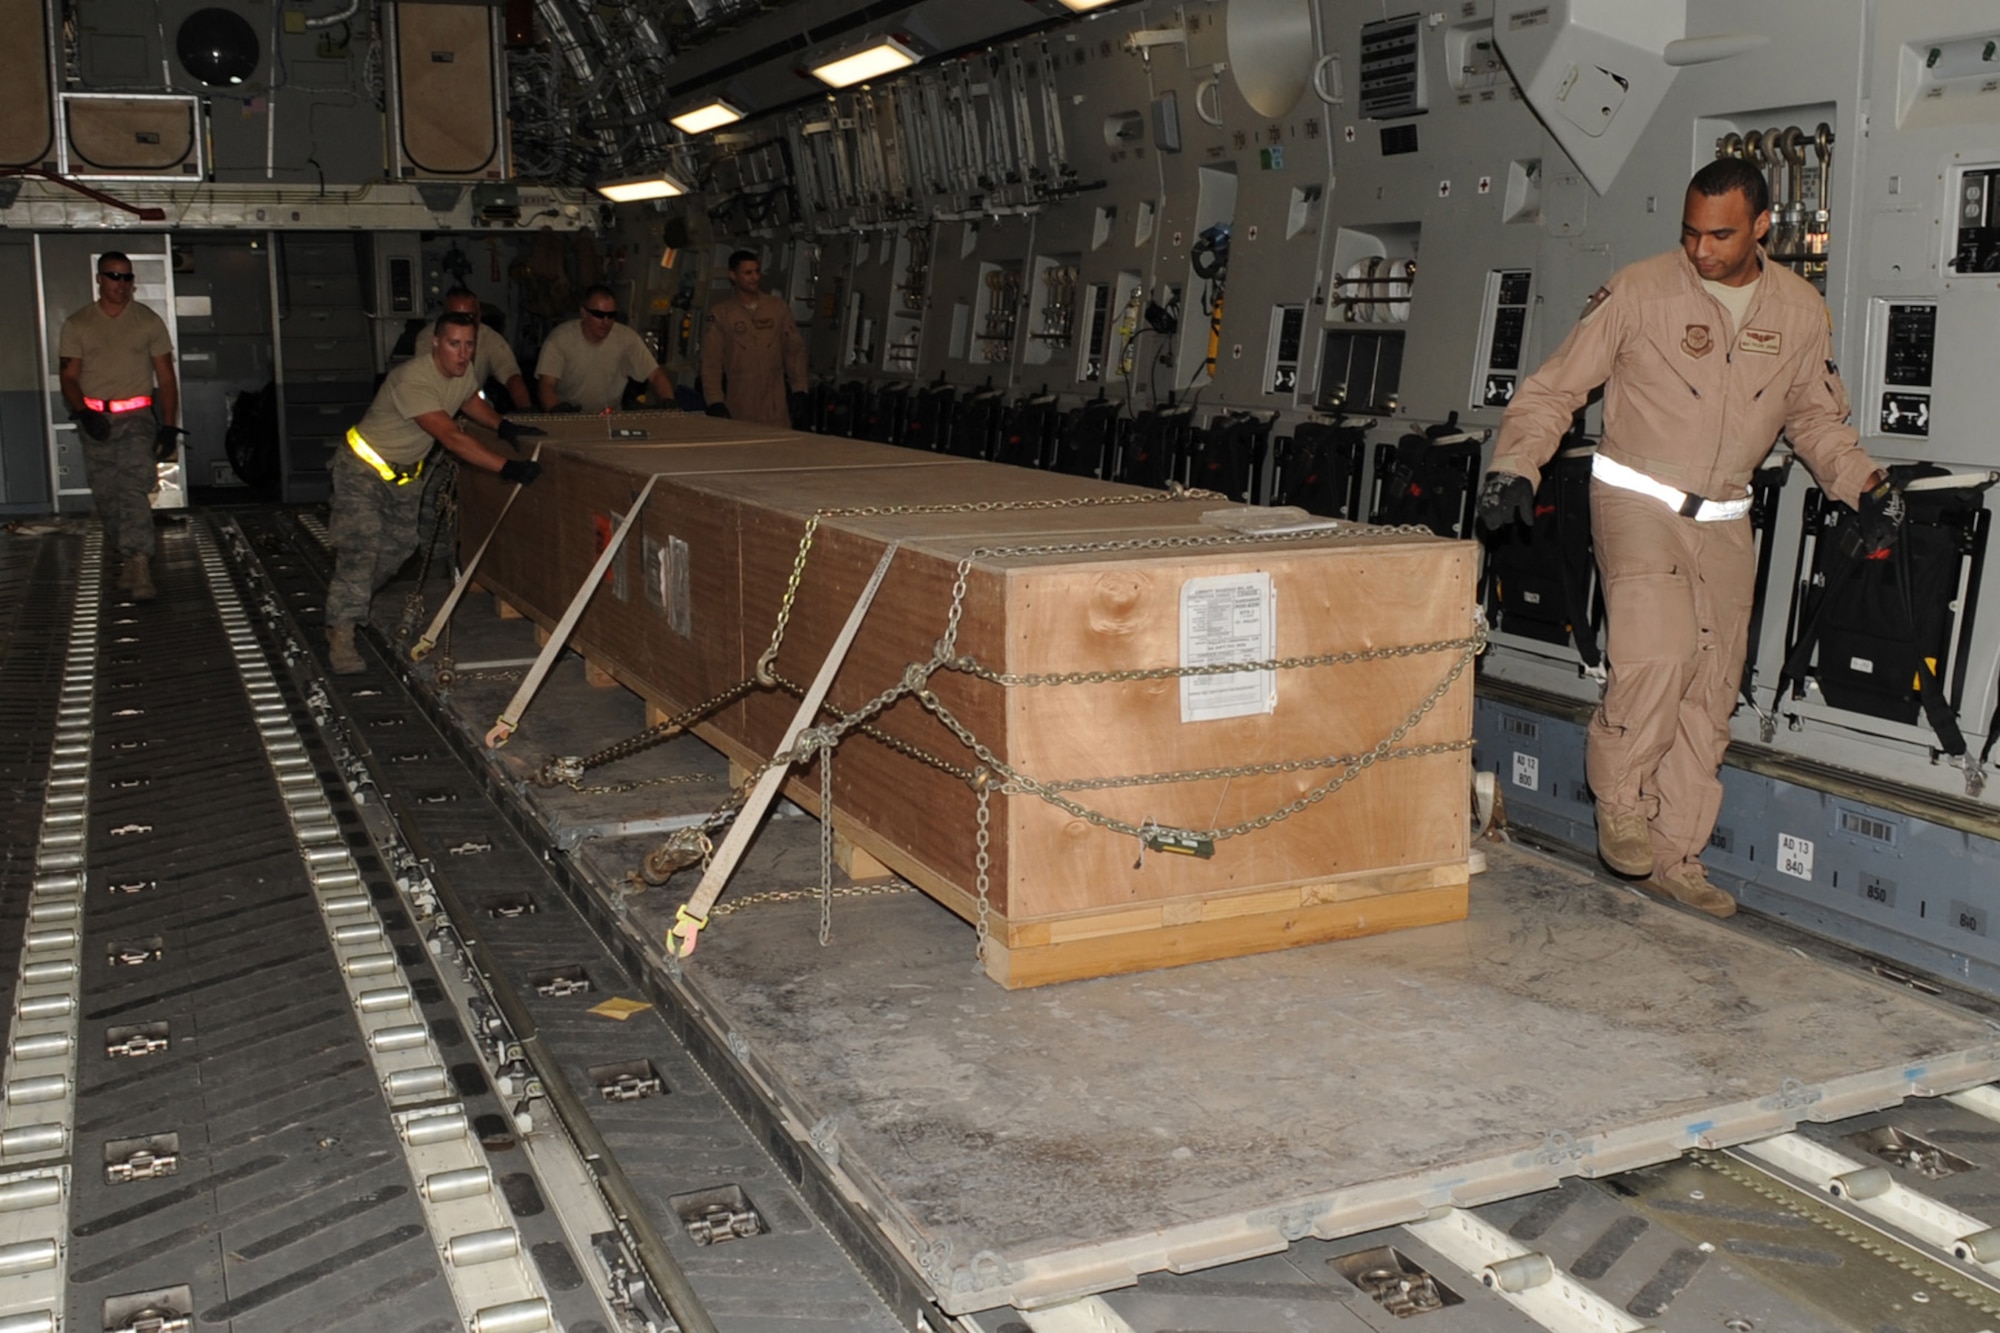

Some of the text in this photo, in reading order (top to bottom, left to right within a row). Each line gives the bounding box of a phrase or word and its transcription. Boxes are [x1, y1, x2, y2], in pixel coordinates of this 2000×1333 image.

[1516, 754, 1535, 770] AD 12
[1518, 773, 1532, 787] 800
[1783, 837, 1809, 855] AD 13
[1785, 859, 1804, 875] 840
[1867, 885, 1887, 903] 850
